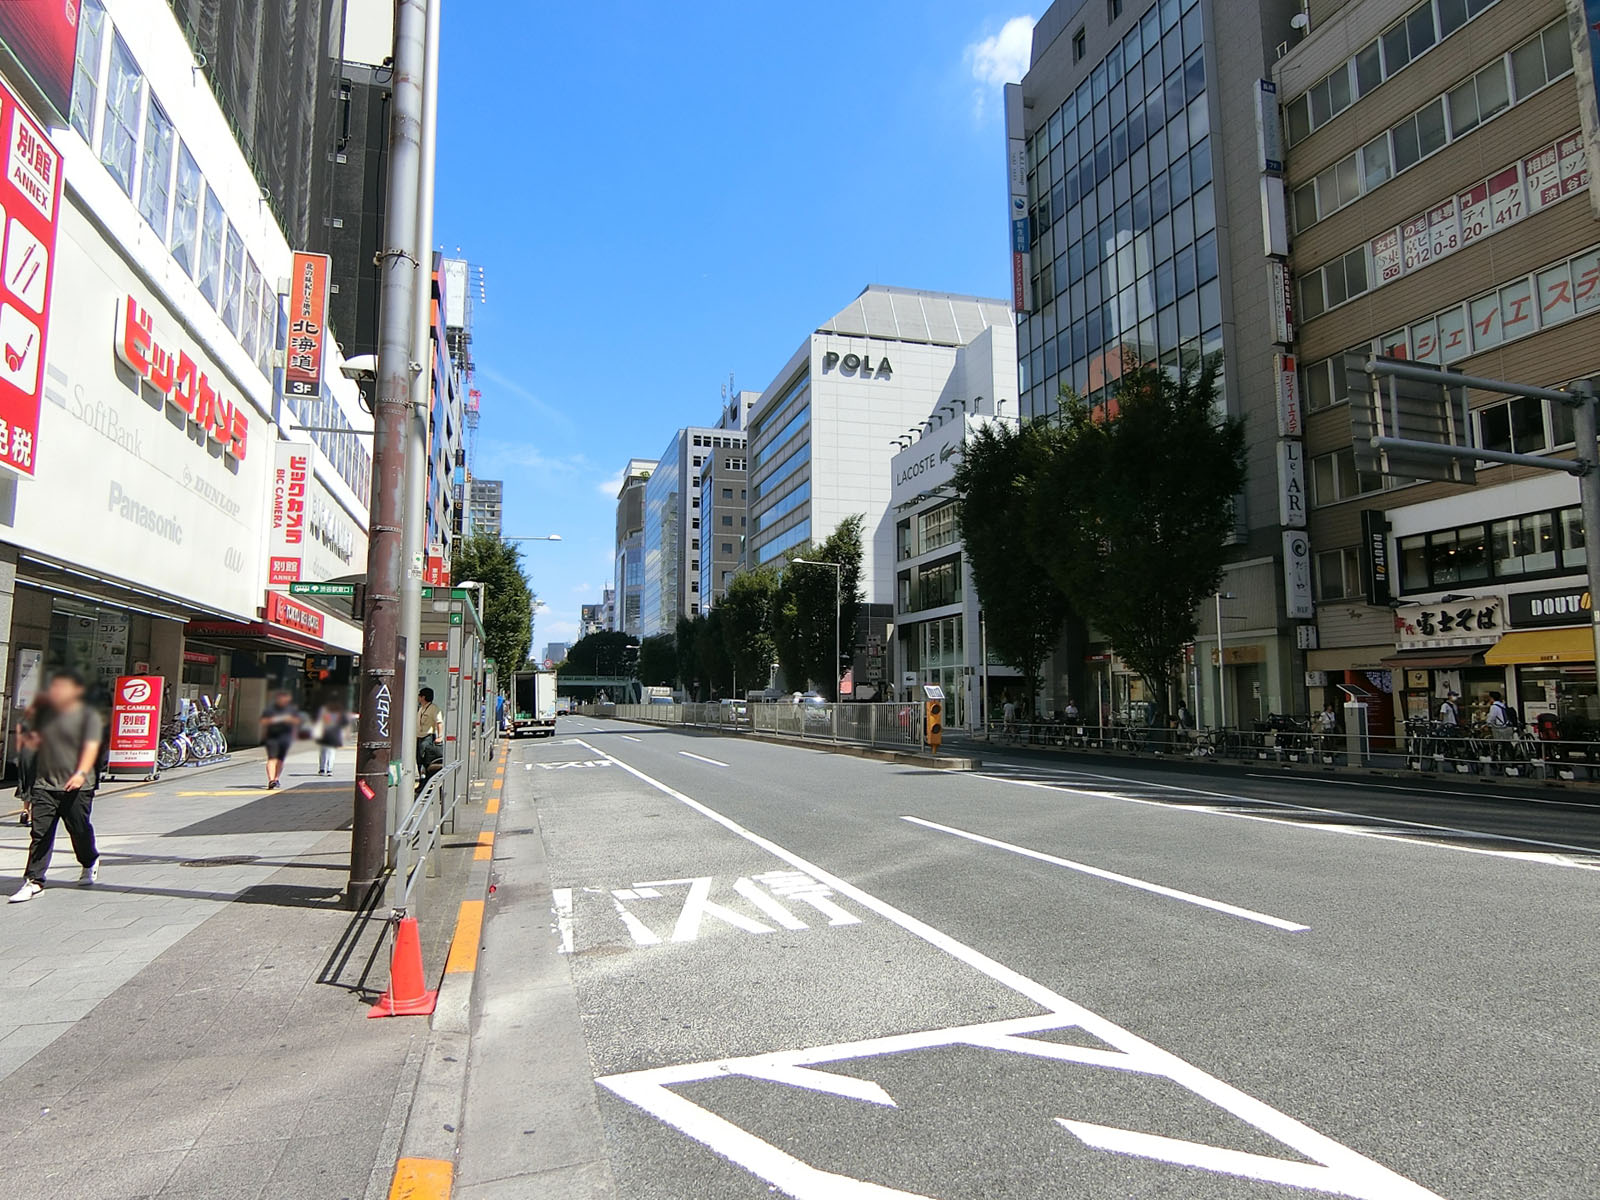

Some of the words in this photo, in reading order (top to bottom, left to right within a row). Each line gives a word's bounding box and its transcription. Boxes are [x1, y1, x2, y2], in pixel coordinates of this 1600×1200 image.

[16, 121, 52, 185] 別館
[14, 166, 49, 210] ANNEX
[291, 319, 319, 373] 北海道
[826, 350, 894, 376] POLA
[120, 294, 249, 461] ビックカメラ
[293, 382, 312, 394] 3F
[72, 384, 142, 460] SoftBank
[276, 468, 285, 488] BIC
[896, 452, 936, 487] LACOSTE
[108, 479, 183, 546] Panasonic
[194, 474, 241, 518] DUNLOP
[273, 489, 284, 529] CAMERA
[285, 456, 307, 545] ビックカメラ
[224, 546, 245, 573] au
[273, 560, 299, 573] 別館
[1415, 602, 1500, 637] 富士そば
[1531, 591, 1592, 616] DOUTO
[101, 624, 126, 633] ゴルフ
[122, 715, 146, 726] 別館
